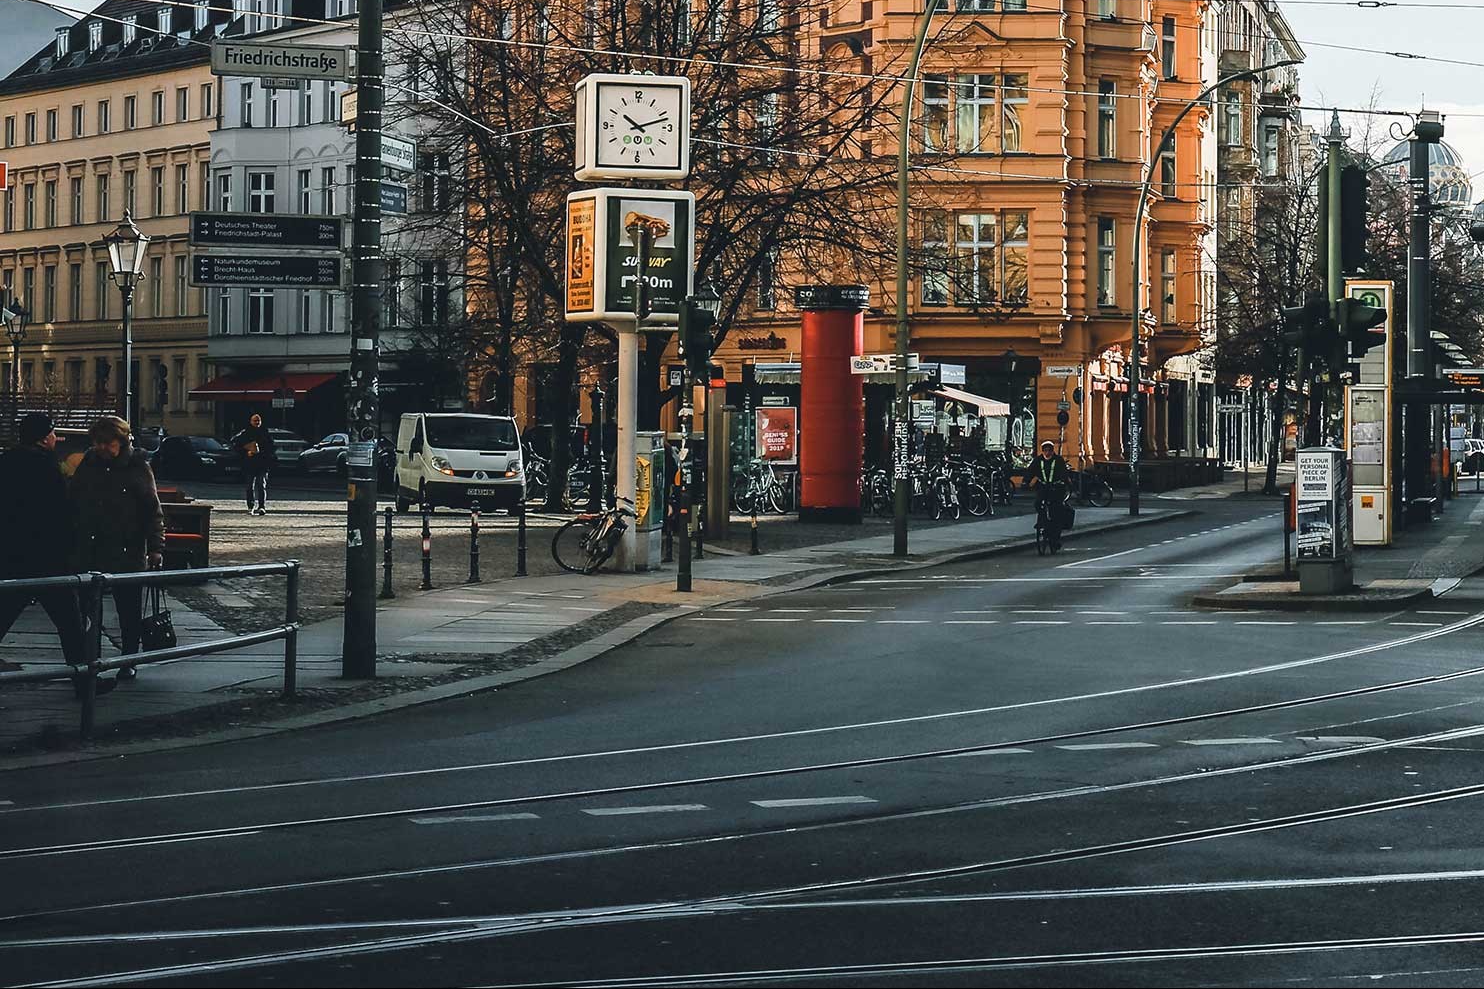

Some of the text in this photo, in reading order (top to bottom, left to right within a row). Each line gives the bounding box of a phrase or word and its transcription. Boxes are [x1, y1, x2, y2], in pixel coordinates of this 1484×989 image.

[224, 47, 338, 73] Friedrichstraße
[634, 90, 643, 99] 12
[602, 121, 673, 132] 9 3
[634, 155, 640, 163] 6
[214, 221, 250, 229] Deutsches
[251, 222, 277, 230] Theater
[214, 229, 282, 238] Friedrichstadt-Palast
[622, 256, 672, 268] SUWAY
